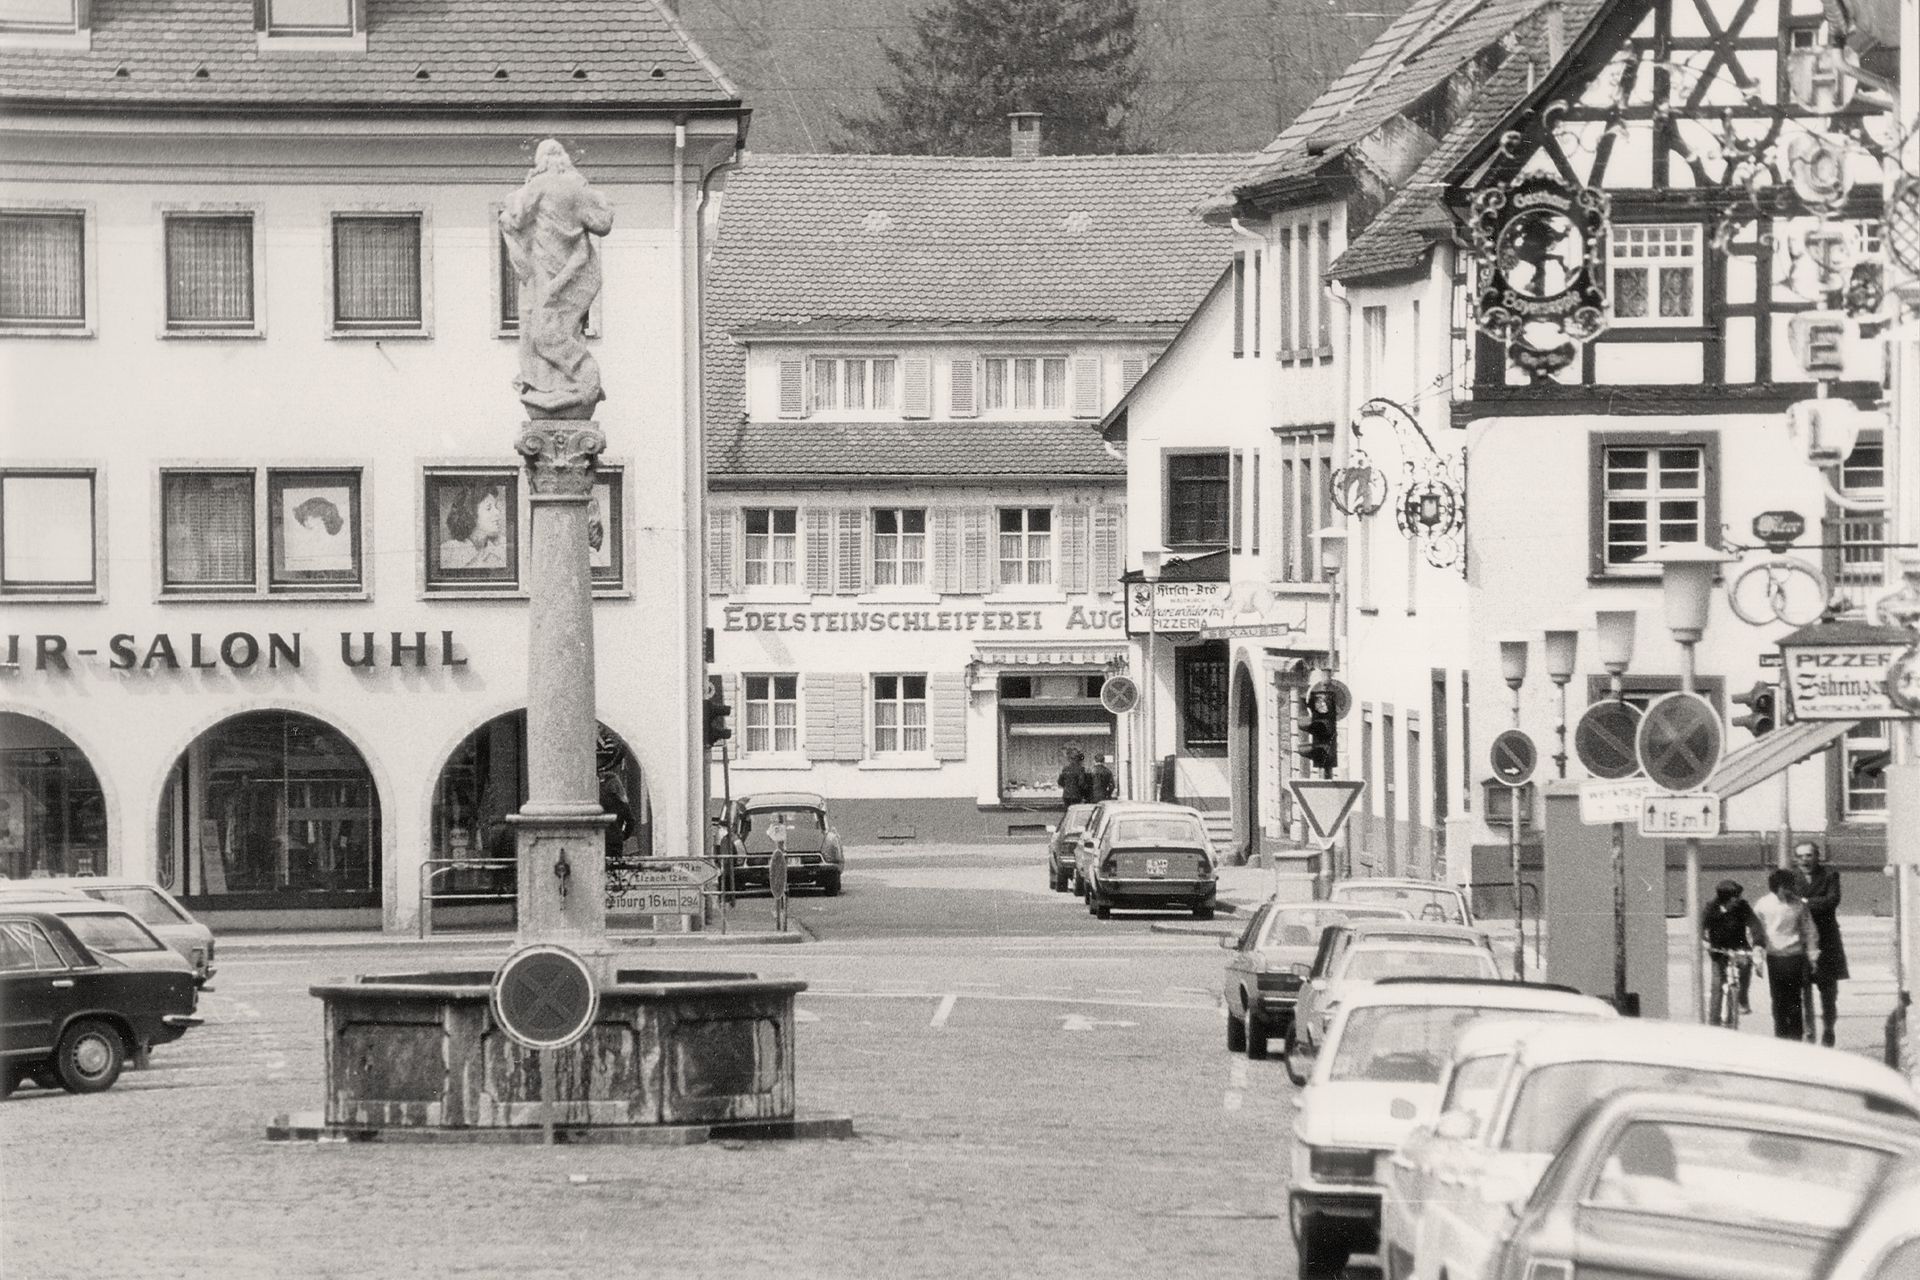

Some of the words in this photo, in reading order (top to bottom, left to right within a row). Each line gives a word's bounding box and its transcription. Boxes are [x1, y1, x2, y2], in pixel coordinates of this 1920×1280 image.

[722, 606, 1043, 632] EDELSTEINSCHLEIFEREI
[1153, 618, 1208, 629] PIZZERIA
[340, 630, 468, 668] UHL
[1664, 811, 1677, 827] 15
[649, 894, 661, 907] 16
[662, 897, 676, 907] km
